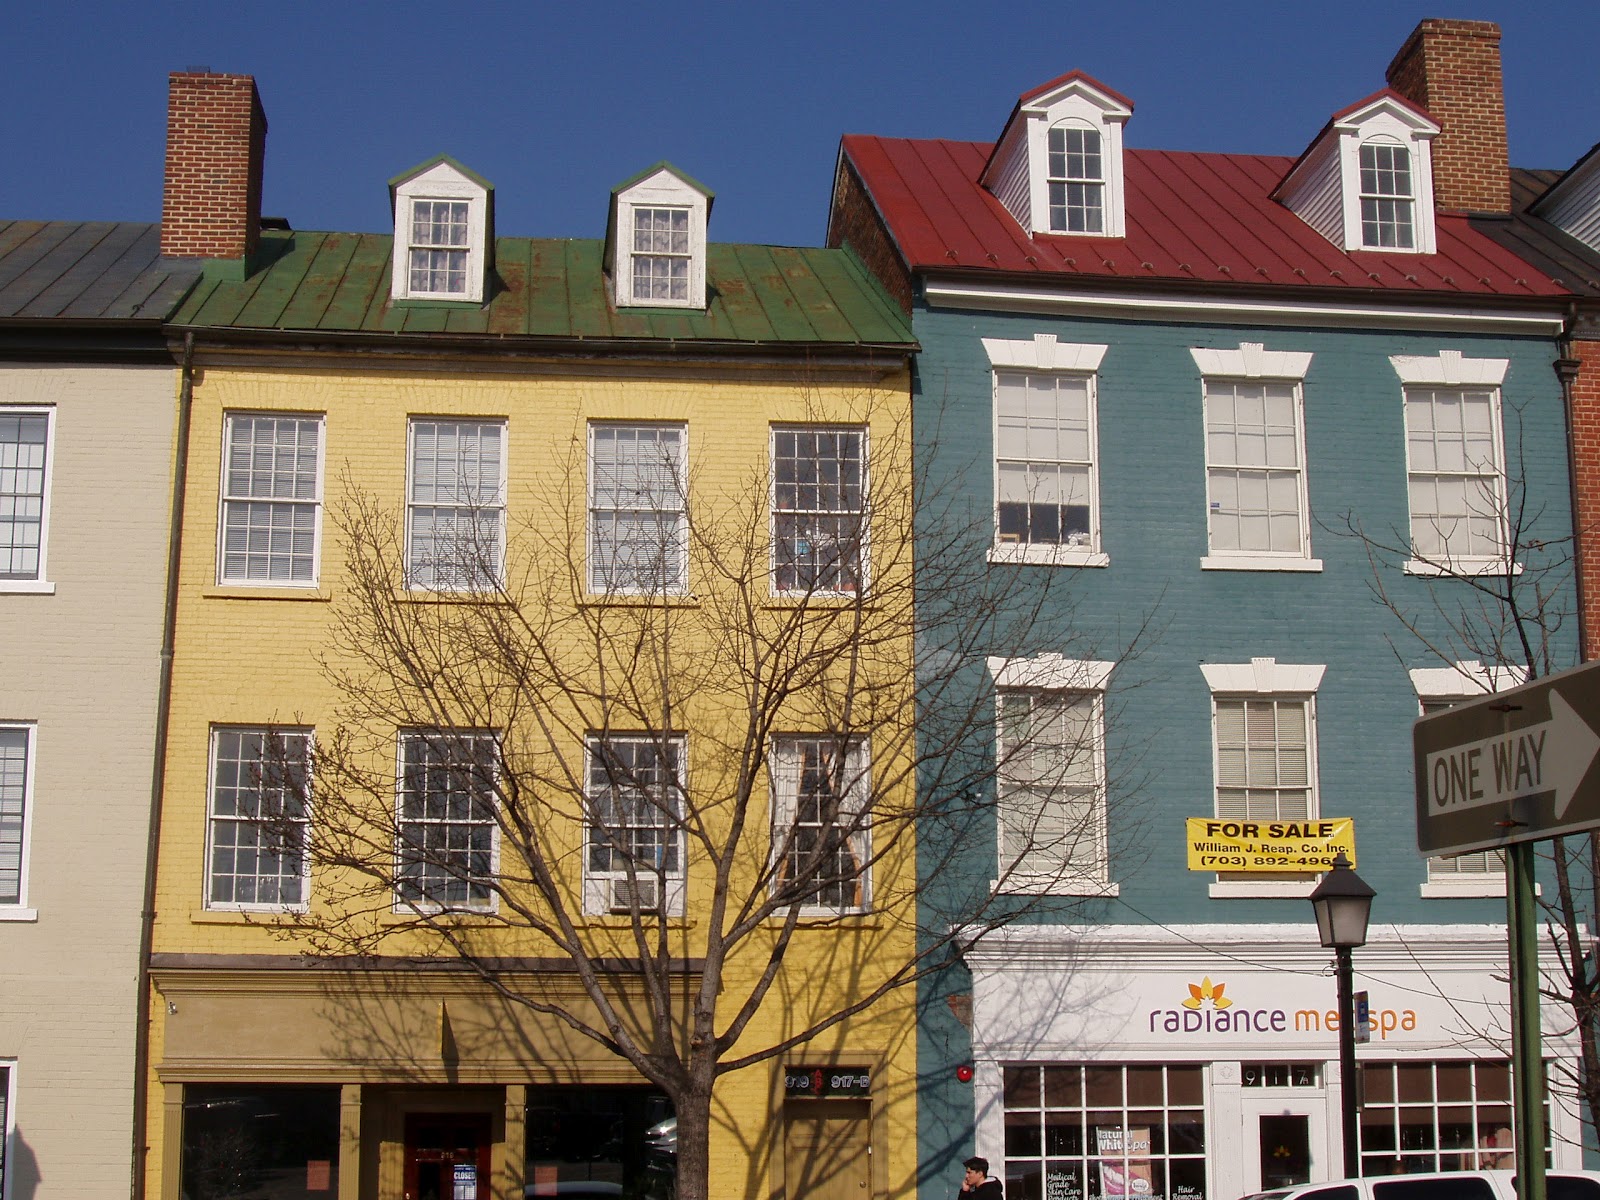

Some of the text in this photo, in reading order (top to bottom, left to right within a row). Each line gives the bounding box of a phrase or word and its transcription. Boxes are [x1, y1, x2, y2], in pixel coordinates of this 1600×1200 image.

[1434, 729, 1547, 807] ONE WAY
[1206, 823, 1334, 838] FOR SALE
[1194, 842, 1241, 853] William
[1245, 844, 1257, 853] J.
[1301, 844, 1322, 853] Co.
[1326, 844, 1349, 853] Inc.
[1201, 856, 1338, 867] (703) 892-496
[1295, 1009, 1416, 1040] mespa
[785, 1075, 809, 1088] 919
[831, 1075, 870, 1088] 917-B
[453, 1171, 475, 1179] CLOSED
[1047, 1172, 1077, 1181] Medical
[1177, 1185, 1195, 1194] Hair
